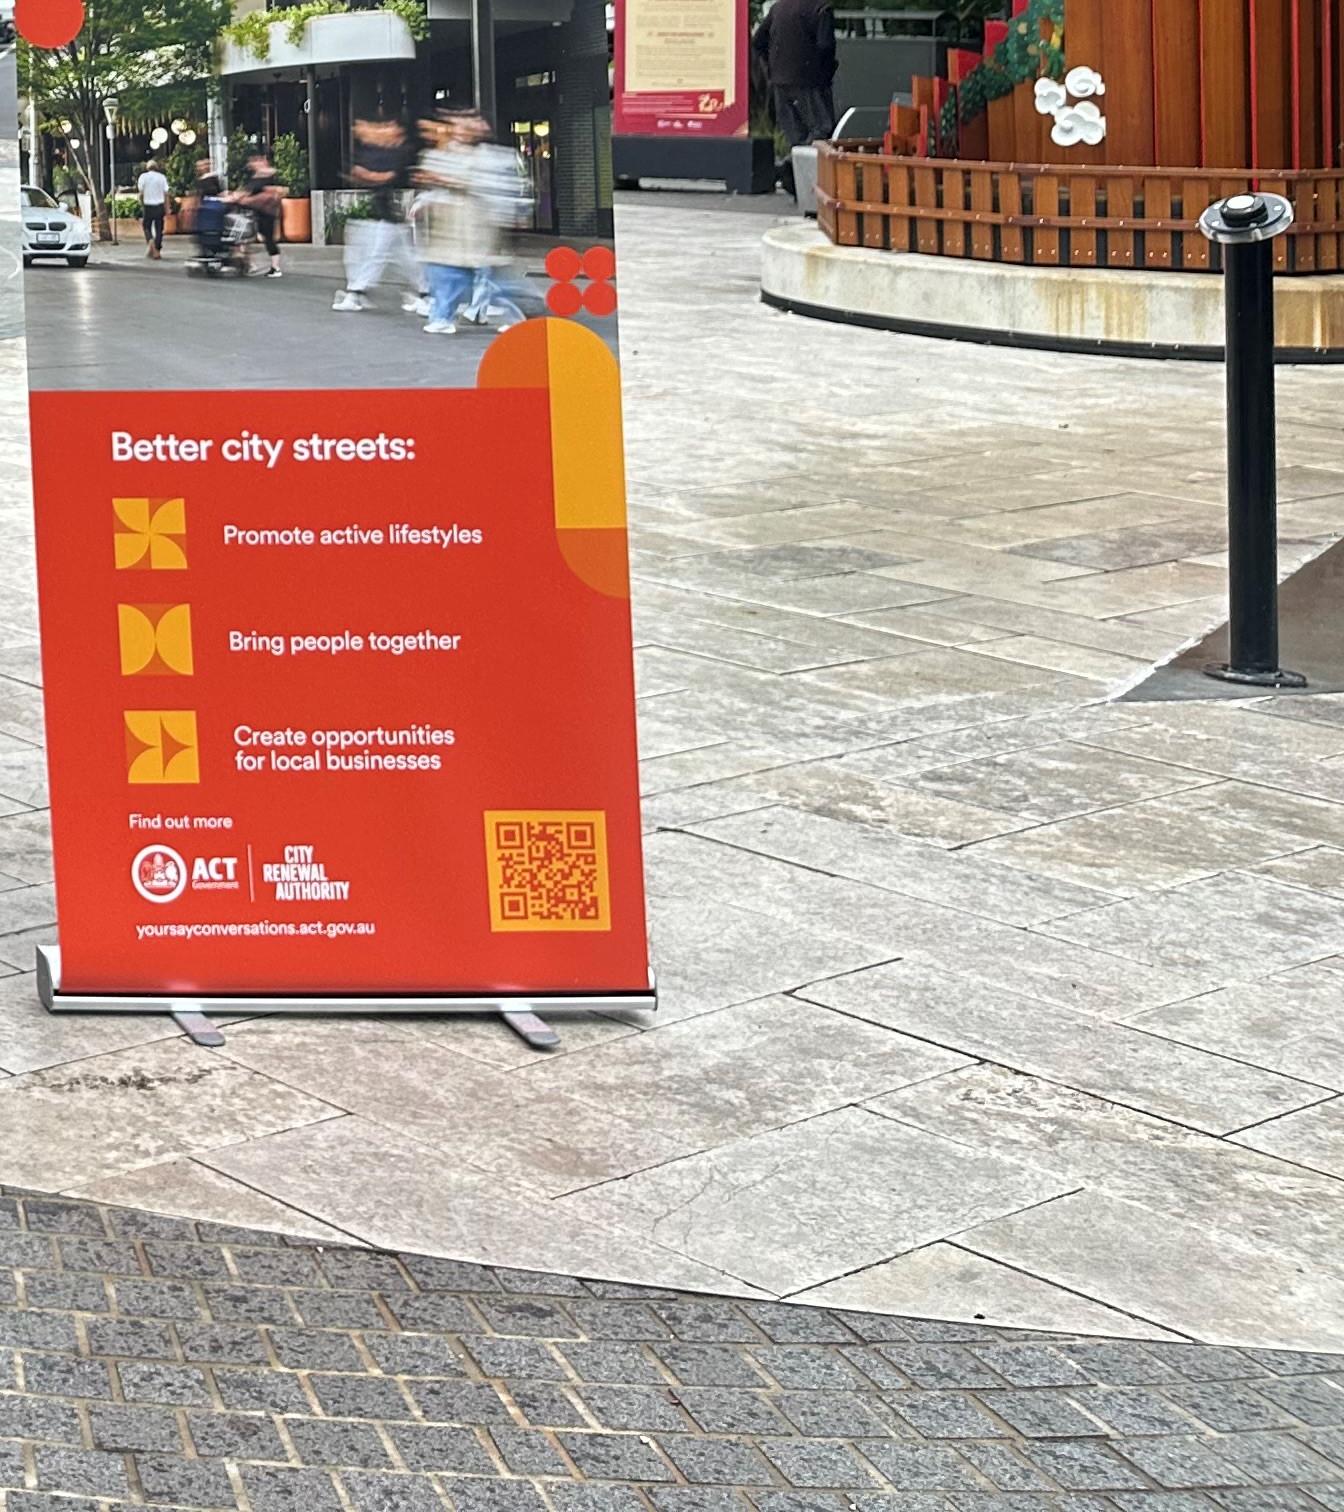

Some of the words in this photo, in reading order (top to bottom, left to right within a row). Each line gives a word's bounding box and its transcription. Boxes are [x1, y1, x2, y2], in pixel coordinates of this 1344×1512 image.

[112, 431, 213, 461] Better
[221, 430, 284, 468] city
[292, 433, 415, 461] streets:
[223, 524, 315, 545] Promote
[320, 523, 383, 544] active
[388, 523, 483, 549] lifestyles
[229, 630, 284, 656] Bring
[290, 630, 363, 656] people
[368, 629, 461, 656] together
[233, 725, 307, 746] Create
[311, 724, 456, 750] opportunities
[235, 750, 265, 771] for
[271, 750, 321, 771] local
[326, 749, 442, 771] businesses
[129, 814, 161, 829] Find
[165, 815, 190, 829] out
[193, 816, 233, 829] more
[284, 845, 313, 863] CITY
[192, 857, 237, 881] ACT
[263, 863, 328, 882] RENEWAL
[275, 881, 350, 900] AUTHORITY
[136, 920, 375, 939] yoursayconversations.act.gov.au
